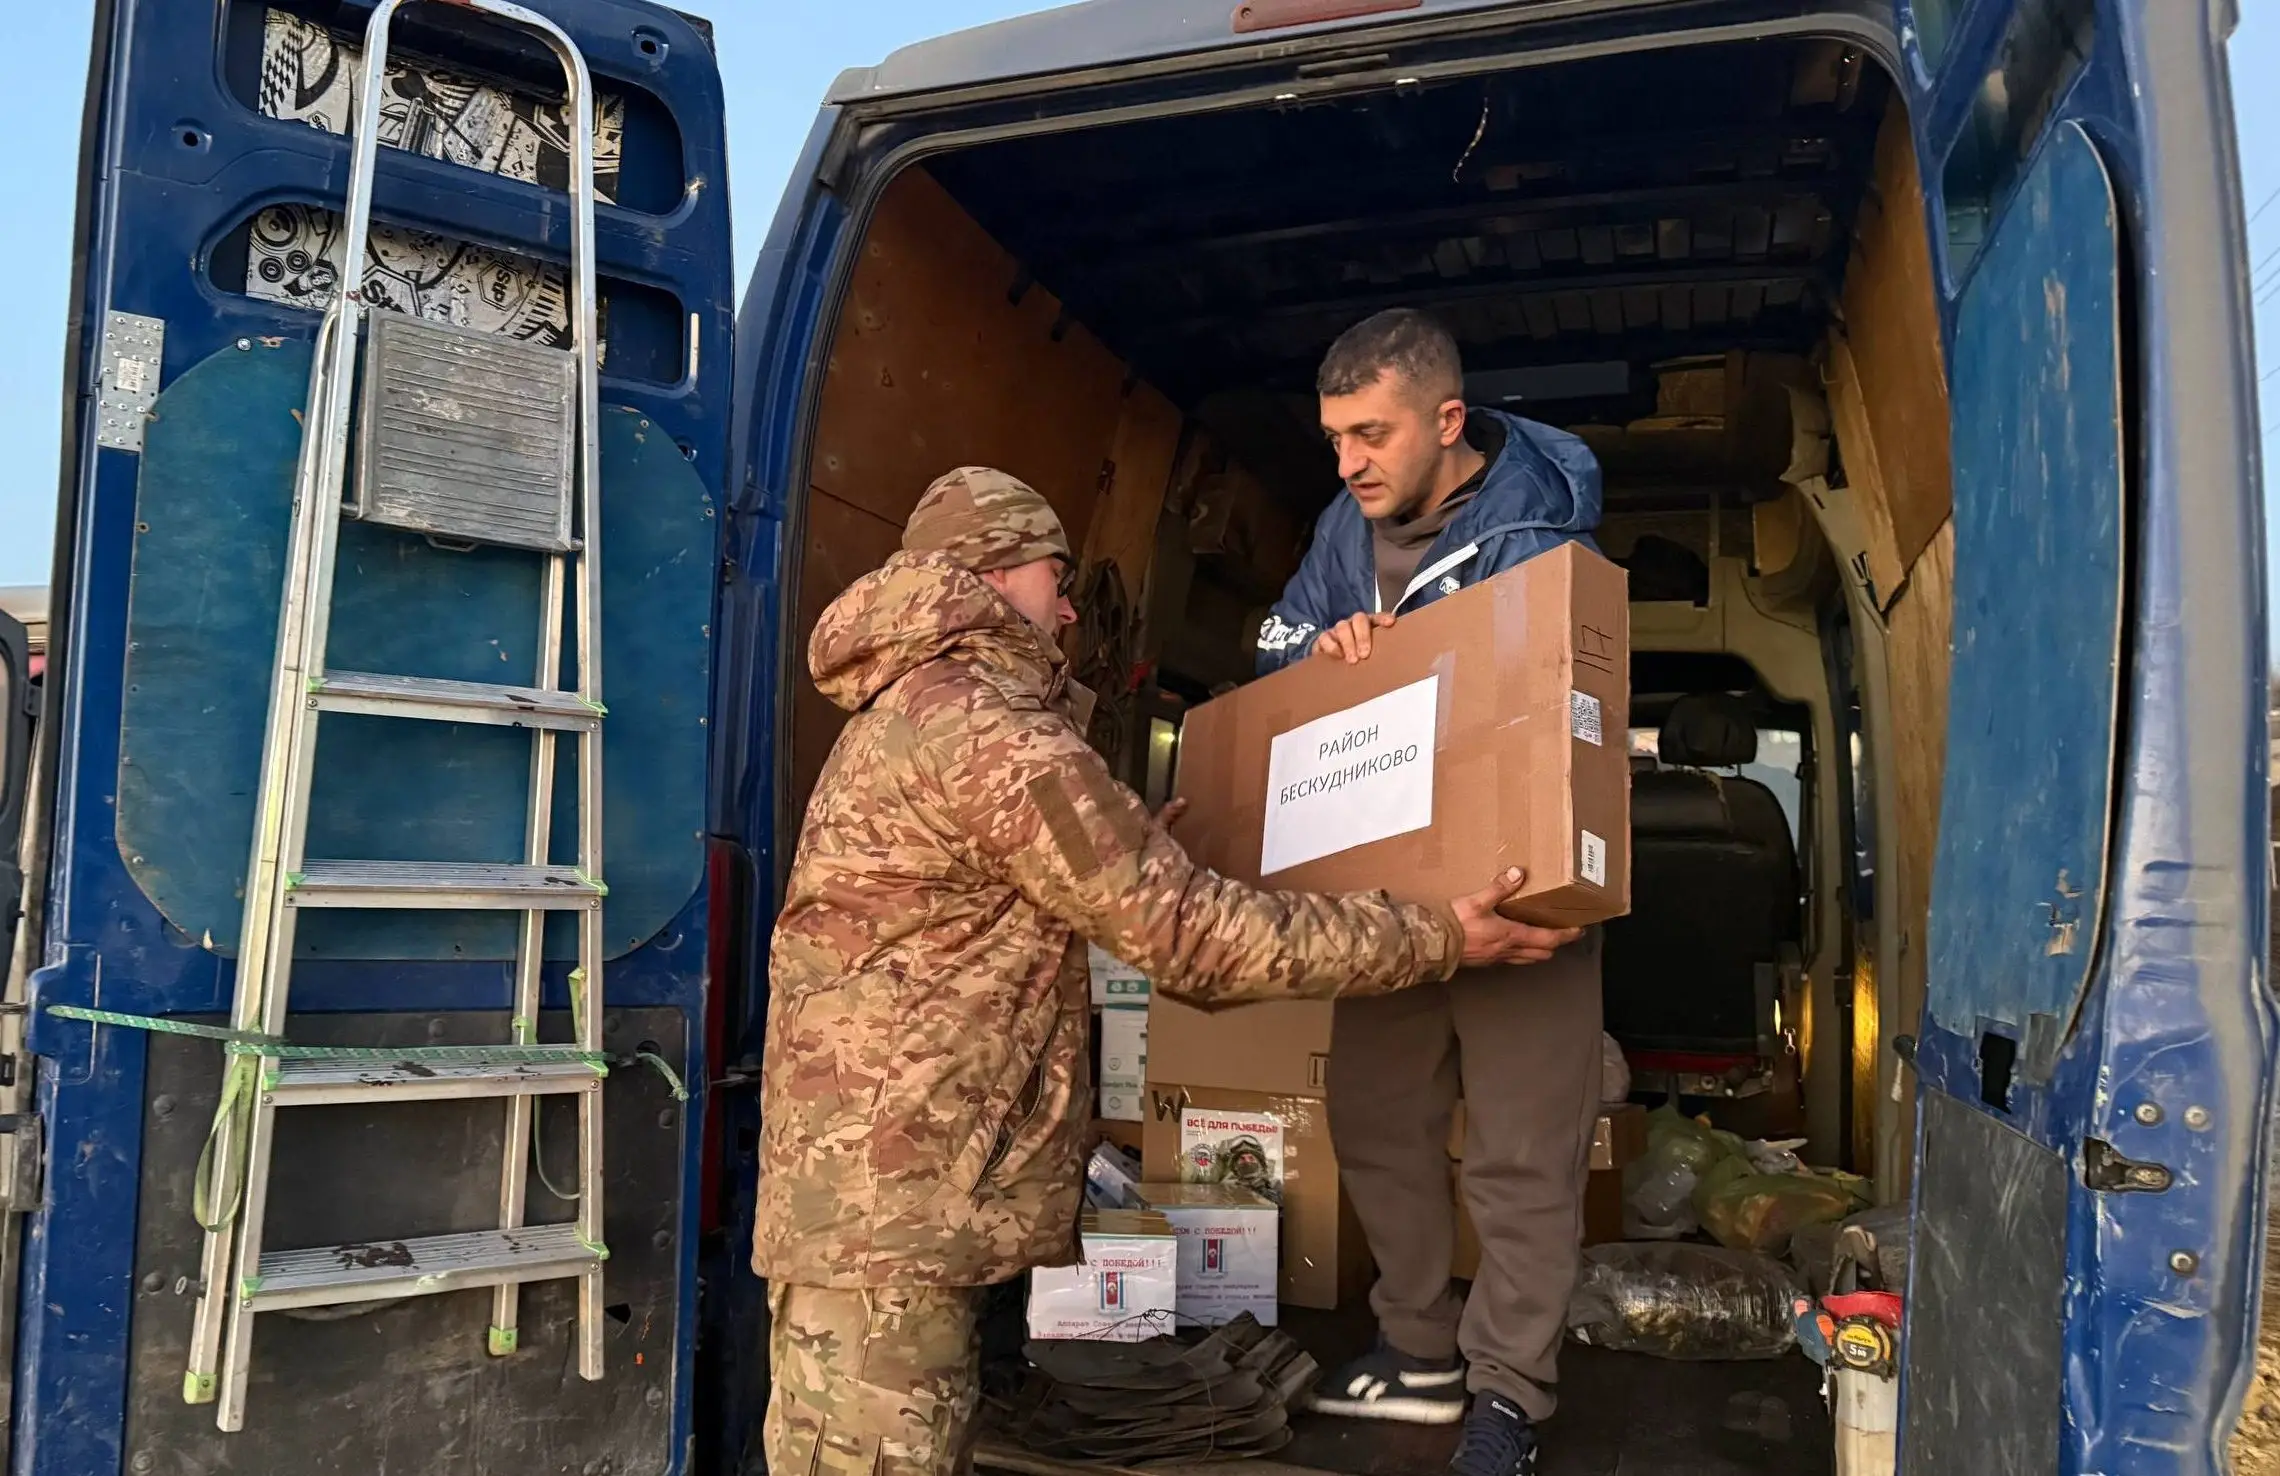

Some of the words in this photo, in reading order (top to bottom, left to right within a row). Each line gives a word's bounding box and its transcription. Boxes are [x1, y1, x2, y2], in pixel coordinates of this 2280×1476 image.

[1573, 624, 1614, 675] 117
[1319, 724, 1379, 761] РАЙОН
[1280, 744, 1418, 805] БЕСКУДНИКОВО
[1186, 1117, 1206, 1128] ВСЁ
[1208, 1120, 1229, 1130] ДЛЯ
